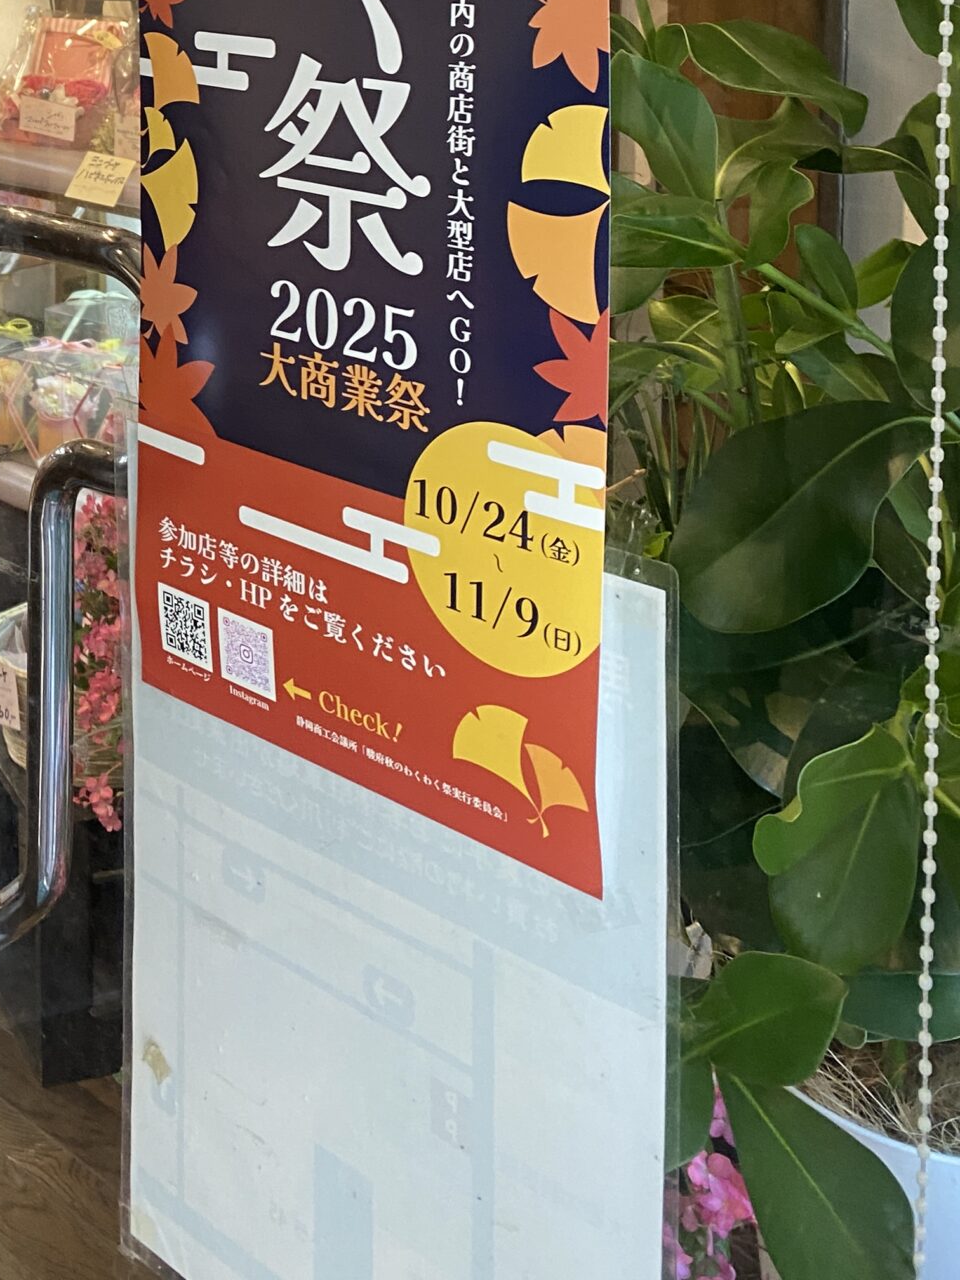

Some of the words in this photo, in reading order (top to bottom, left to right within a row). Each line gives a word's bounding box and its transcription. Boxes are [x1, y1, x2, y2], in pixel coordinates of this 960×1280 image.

[270, 279, 418, 370] 2025
[259, 342, 431, 433] 大商業祭
[158, 516, 329, 604] 参加店等の詳細は
[165, 655, 211, 683] ホームページ
[229, 684, 271, 712] Instagram
[318, 690, 404, 743] Check!
